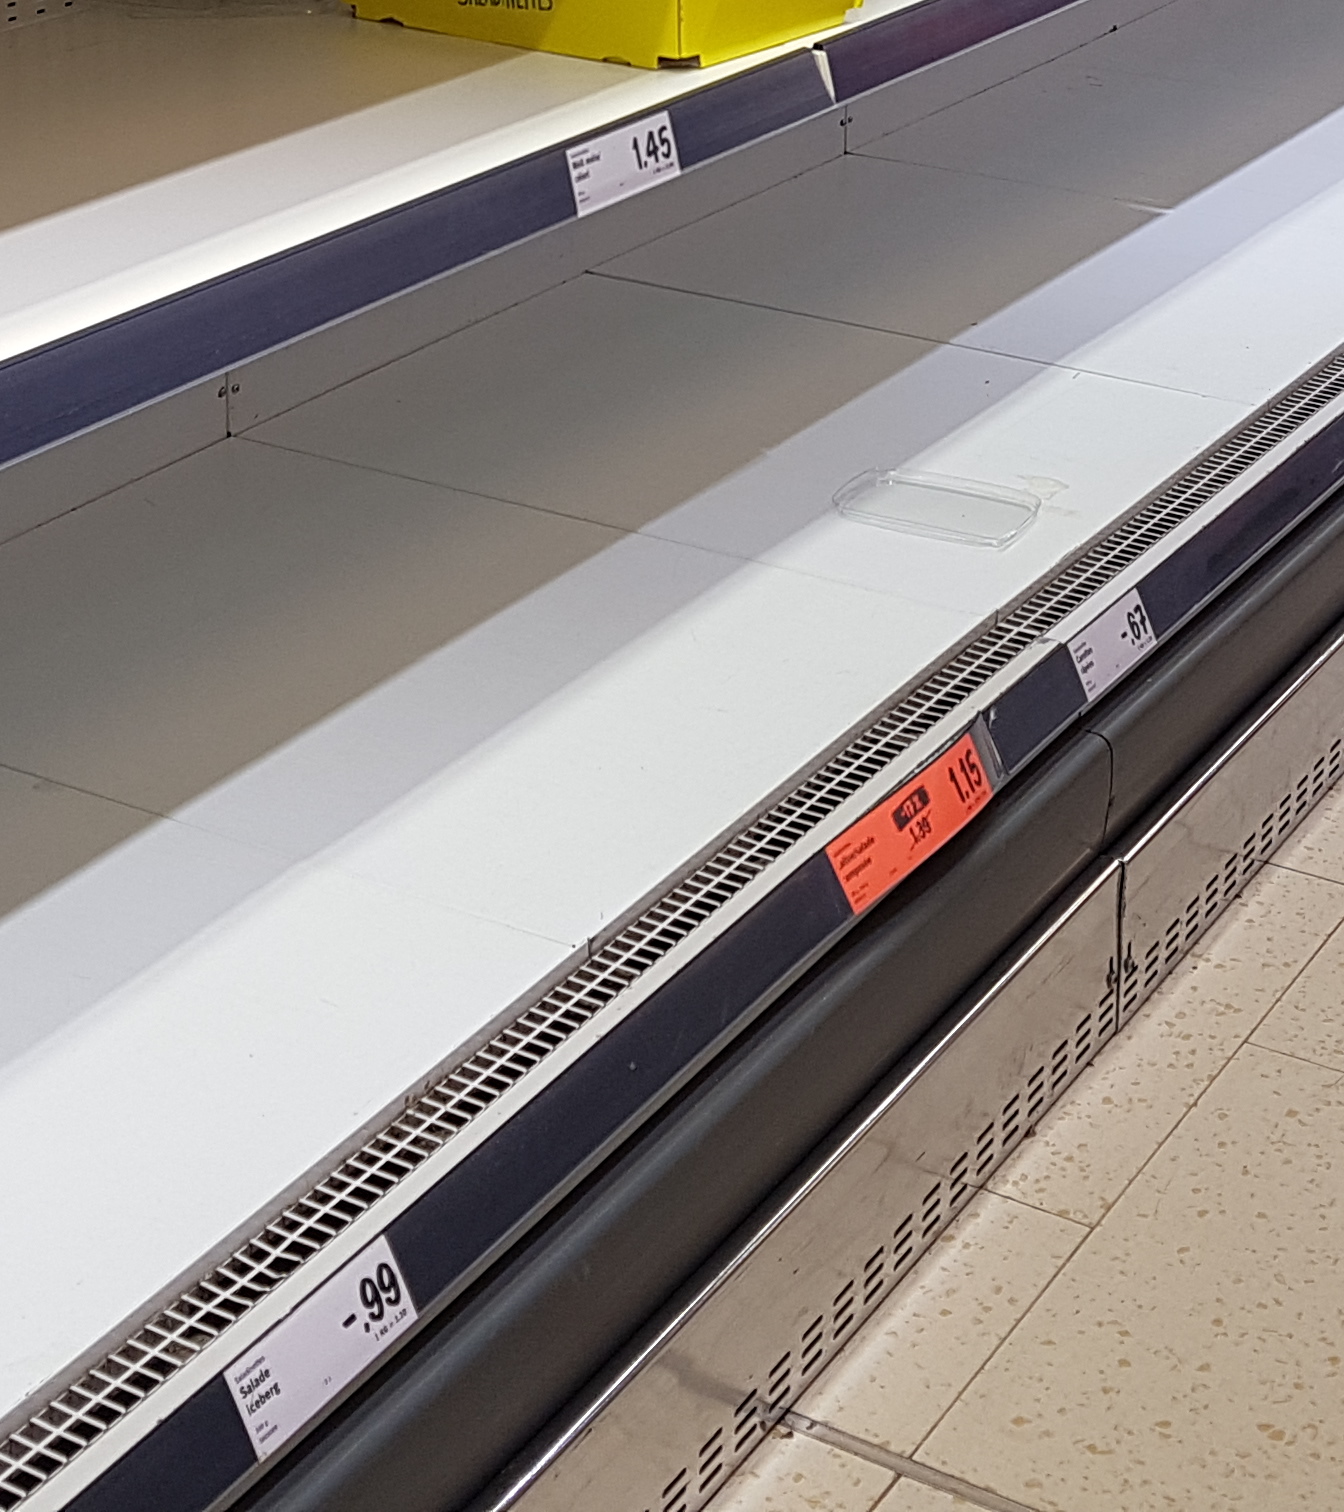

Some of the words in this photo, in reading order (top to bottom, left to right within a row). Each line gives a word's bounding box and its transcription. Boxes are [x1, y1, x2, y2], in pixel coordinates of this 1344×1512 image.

[632, 125, 671, 170] 1.45
[948, 749, 982, 804] 1.15
[240, 1368, 271, 1399] Salade
[246, 1382, 281, 1416] Iceberg
